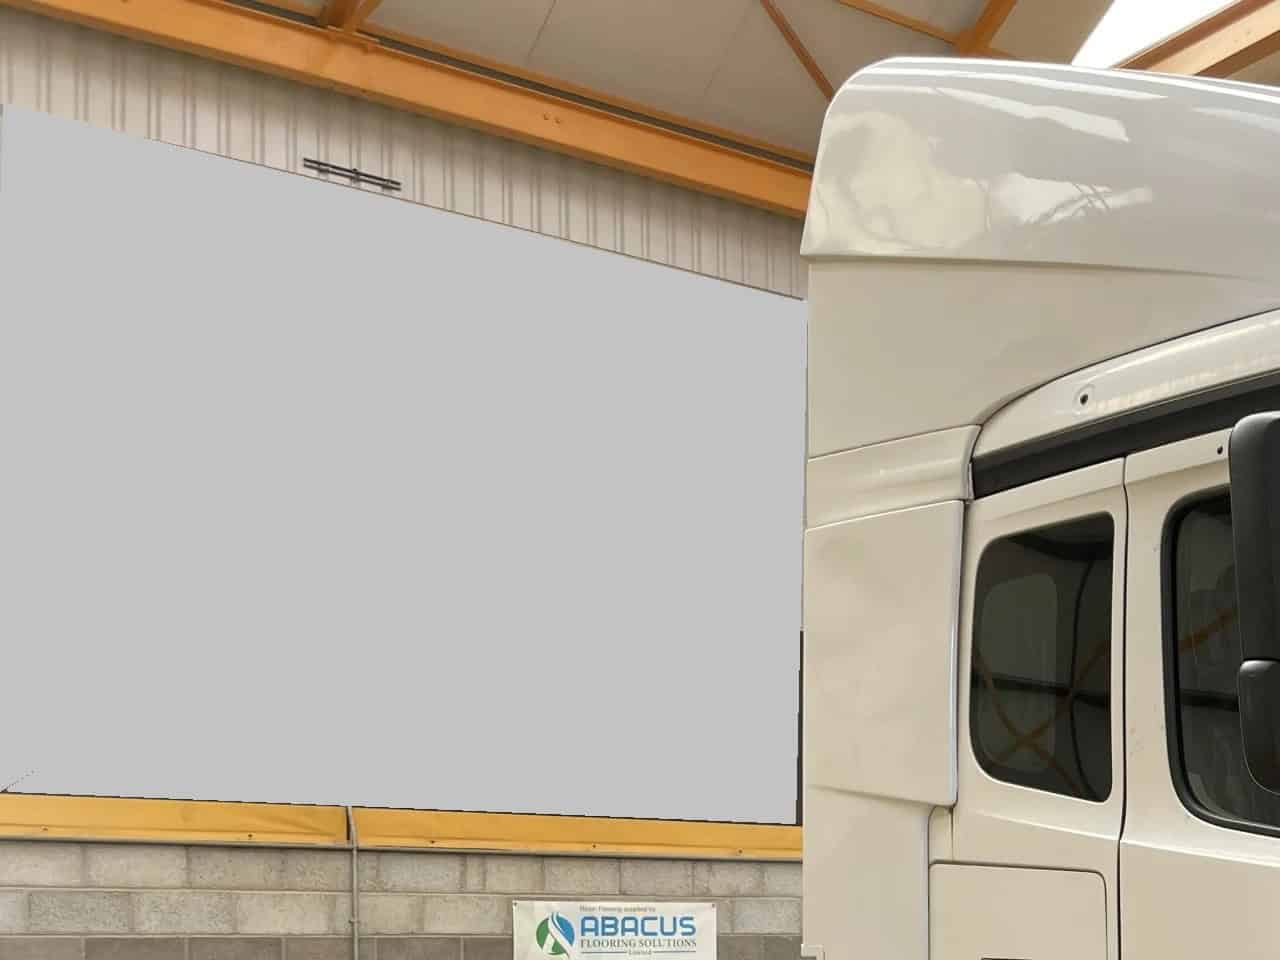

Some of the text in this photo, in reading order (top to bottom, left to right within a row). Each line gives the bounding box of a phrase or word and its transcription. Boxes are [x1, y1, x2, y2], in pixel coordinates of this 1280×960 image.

[580, 916, 697, 937] ABACUS
[580, 938, 697, 949] FLOORING SOLUTIONS
